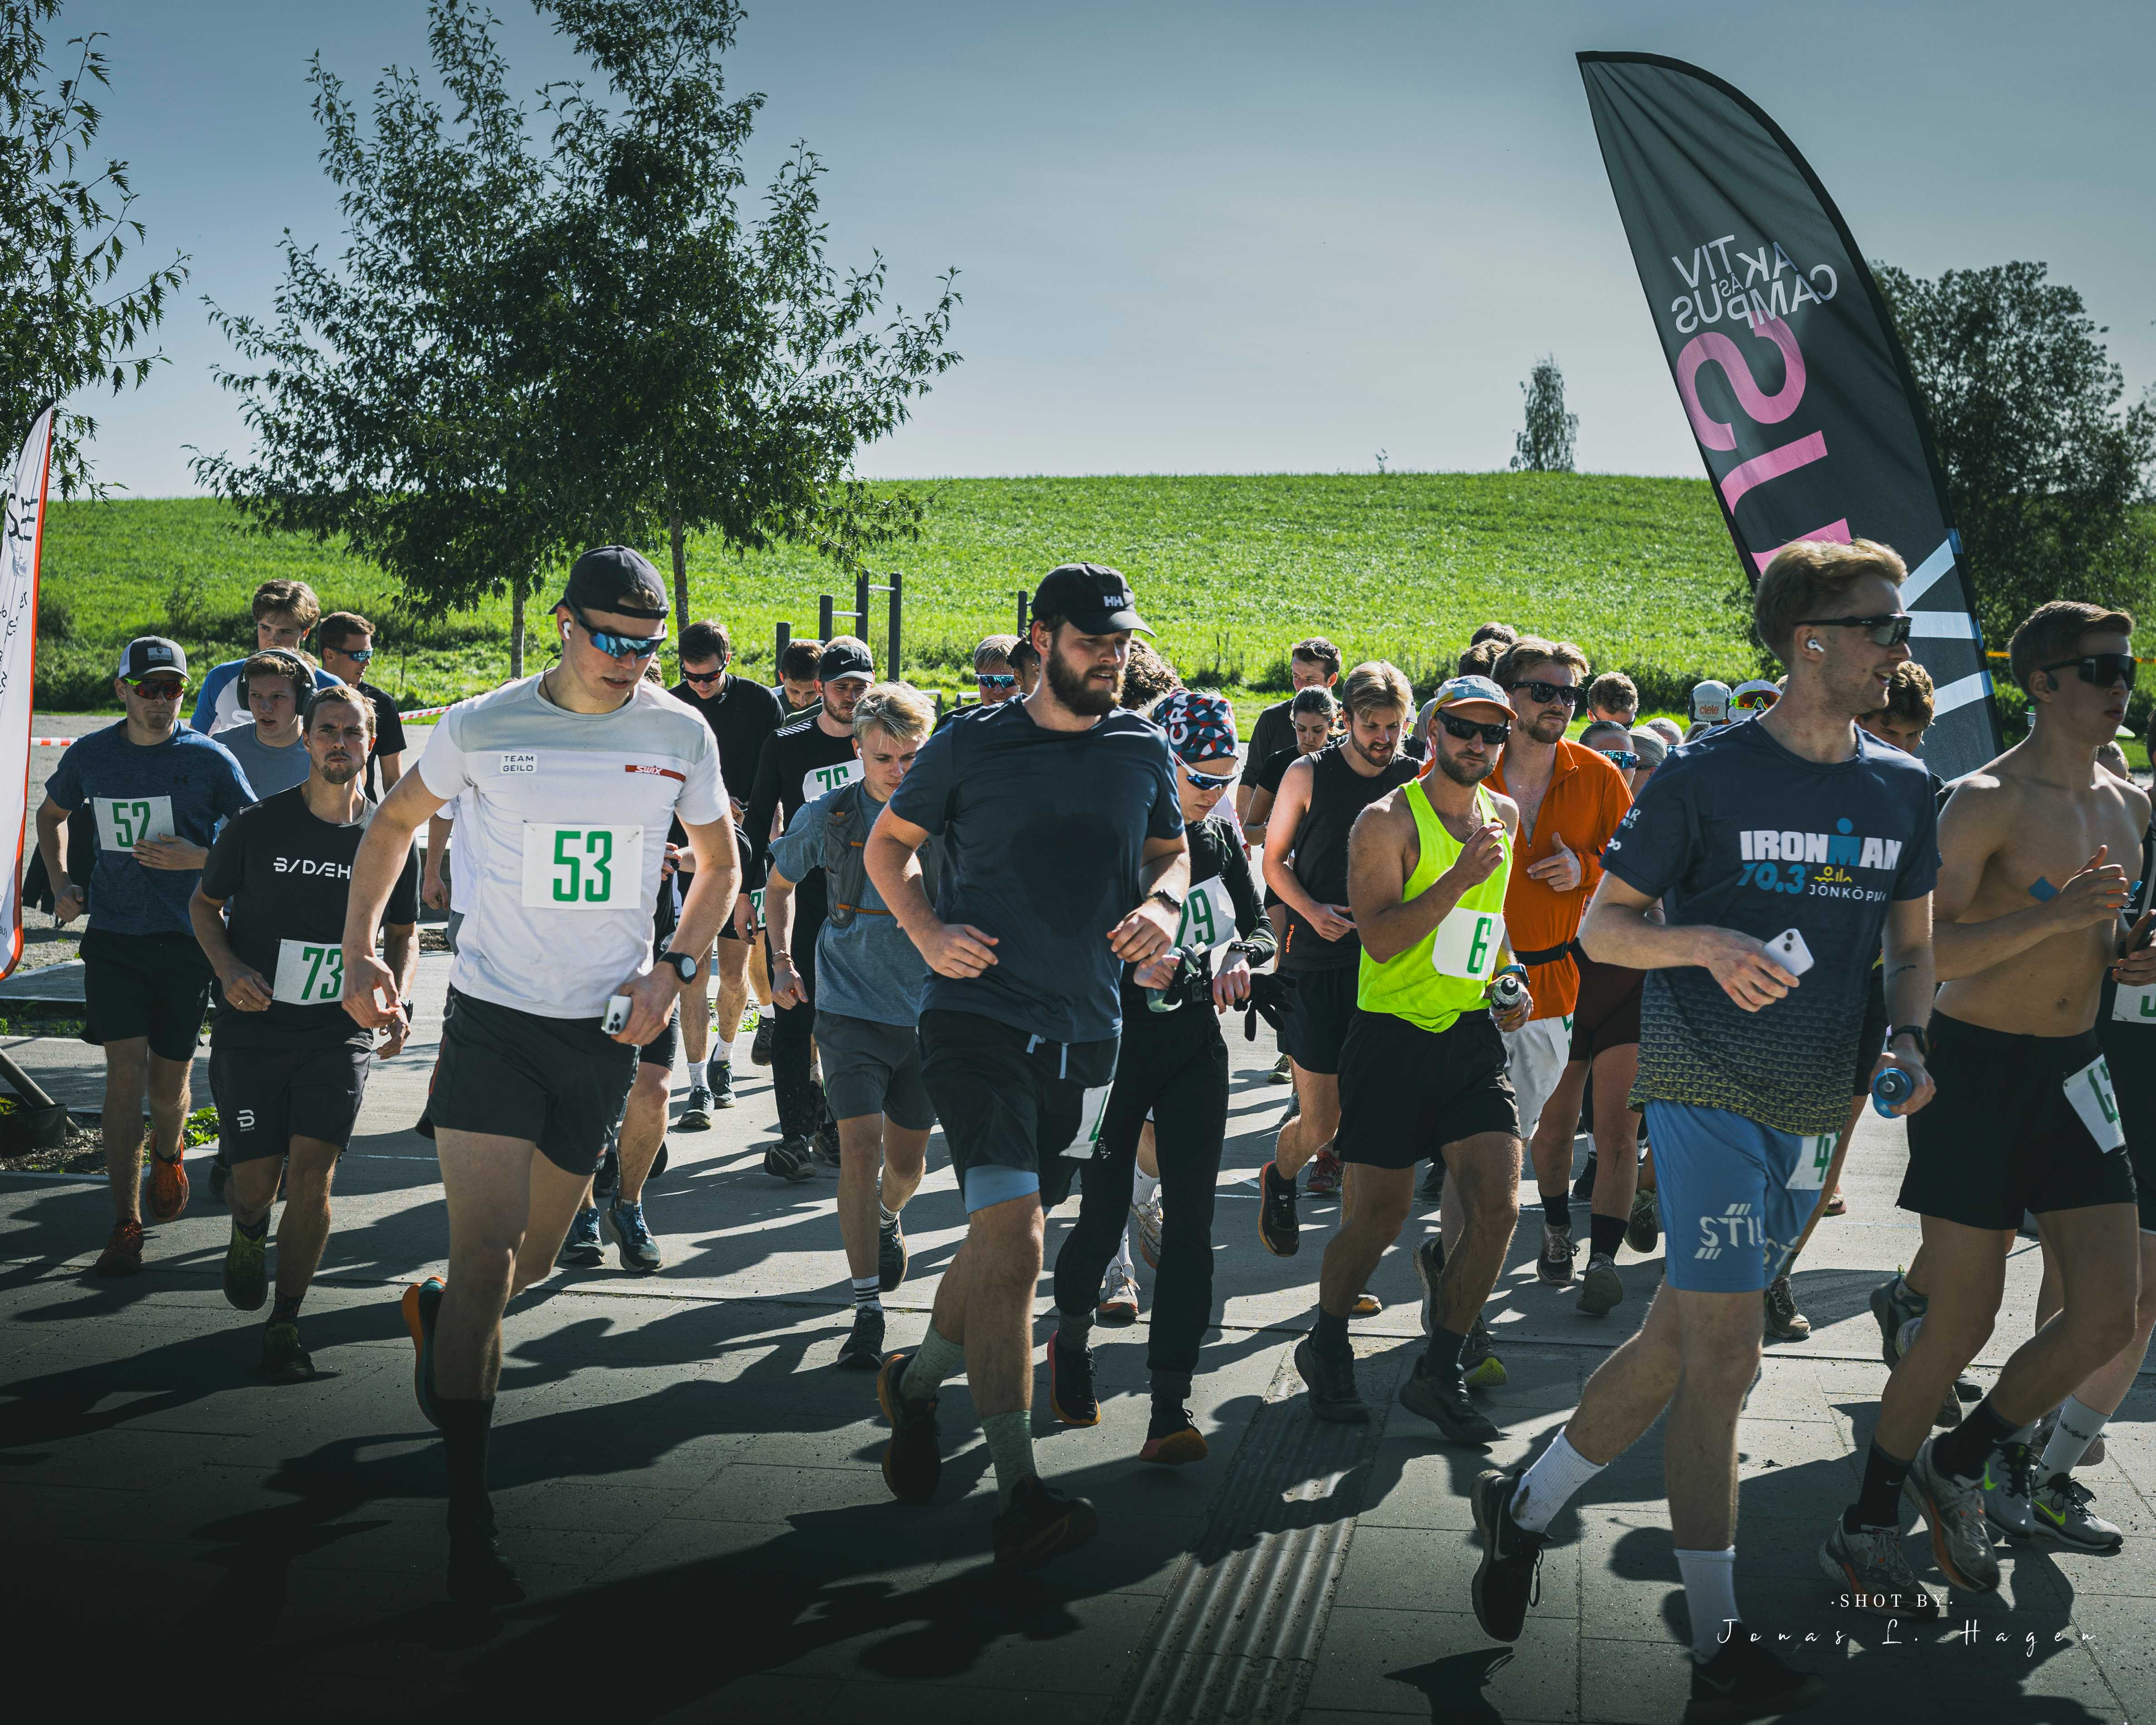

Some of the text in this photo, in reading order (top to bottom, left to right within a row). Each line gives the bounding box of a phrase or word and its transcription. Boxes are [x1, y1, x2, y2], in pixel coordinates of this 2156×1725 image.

[1103, 596, 1124, 607] HH
[112, 801, 151, 847] 52
[553, 830, 612, 902] 53
[1740, 830, 1903, 870] IRONMAN
[1737, 862, 1806, 894] 70.3
[1467, 917, 1492, 974] 6
[301, 946, 345, 1000] 73
